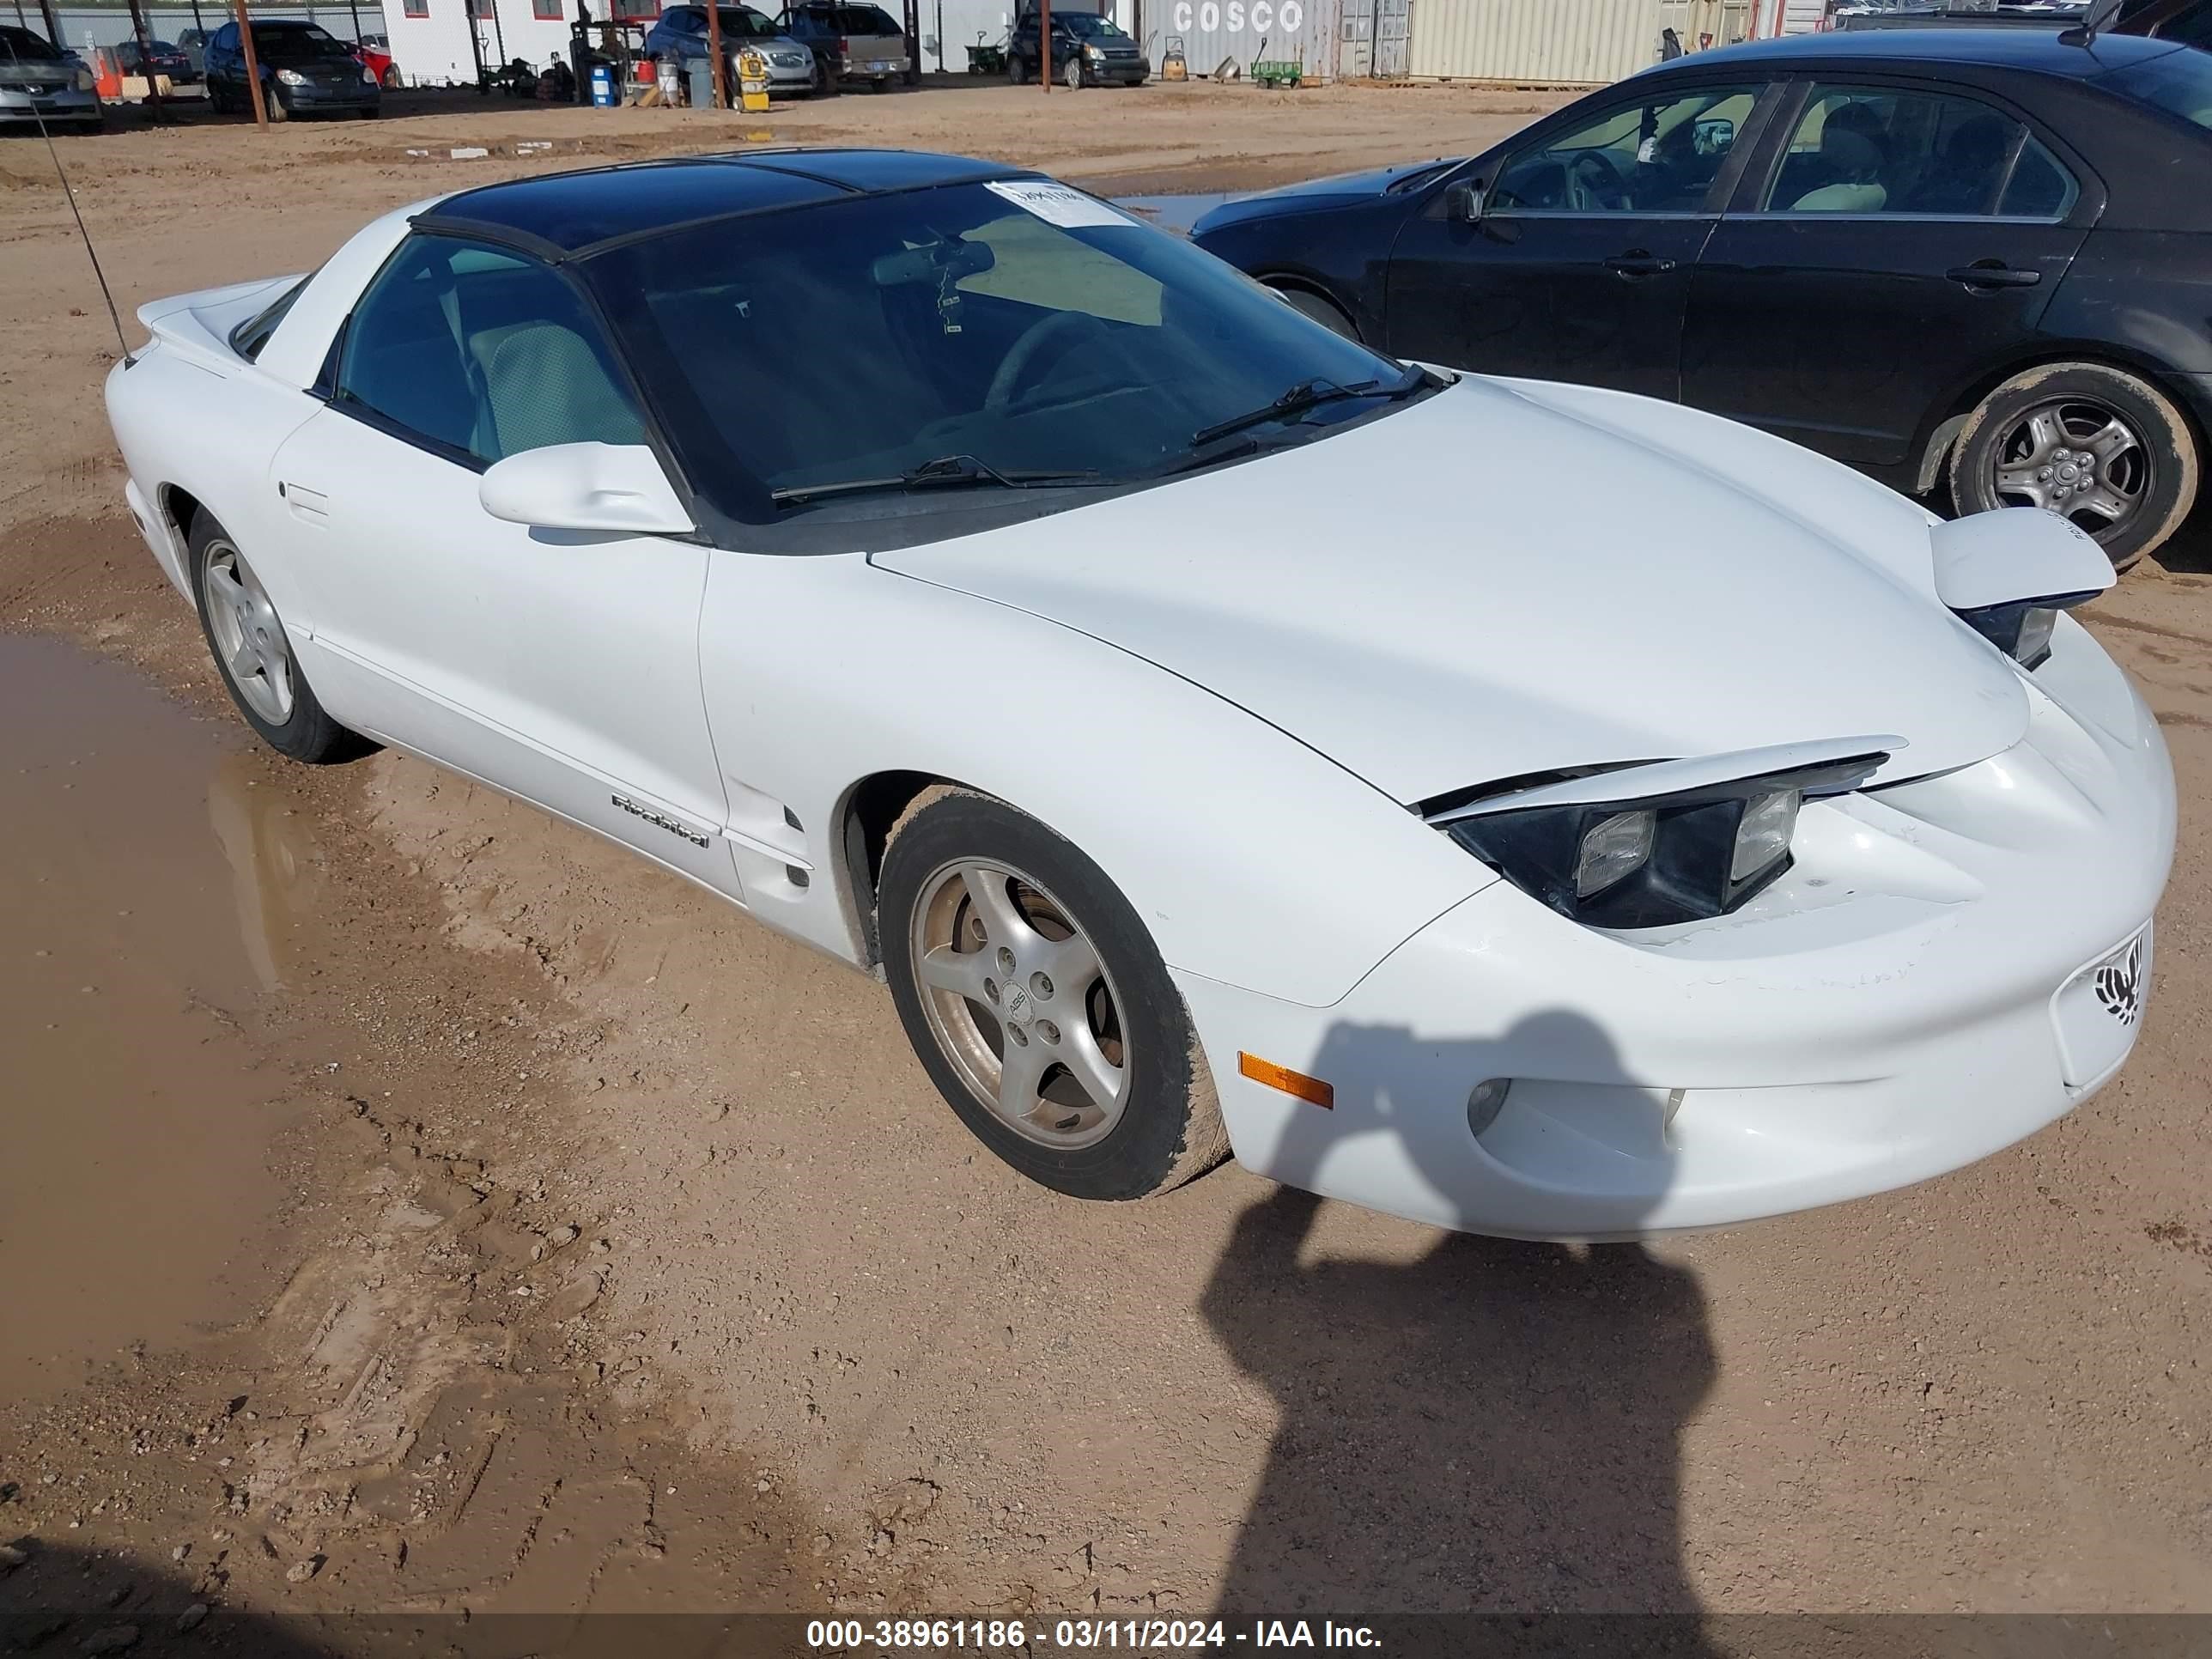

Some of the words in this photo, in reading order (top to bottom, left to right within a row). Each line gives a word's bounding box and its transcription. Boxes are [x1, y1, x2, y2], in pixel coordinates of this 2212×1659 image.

[1173, 1, 1304, 33] COSCO
[611, 792, 709, 848] Firebird
[1009, 992, 1026, 1016] ABS
